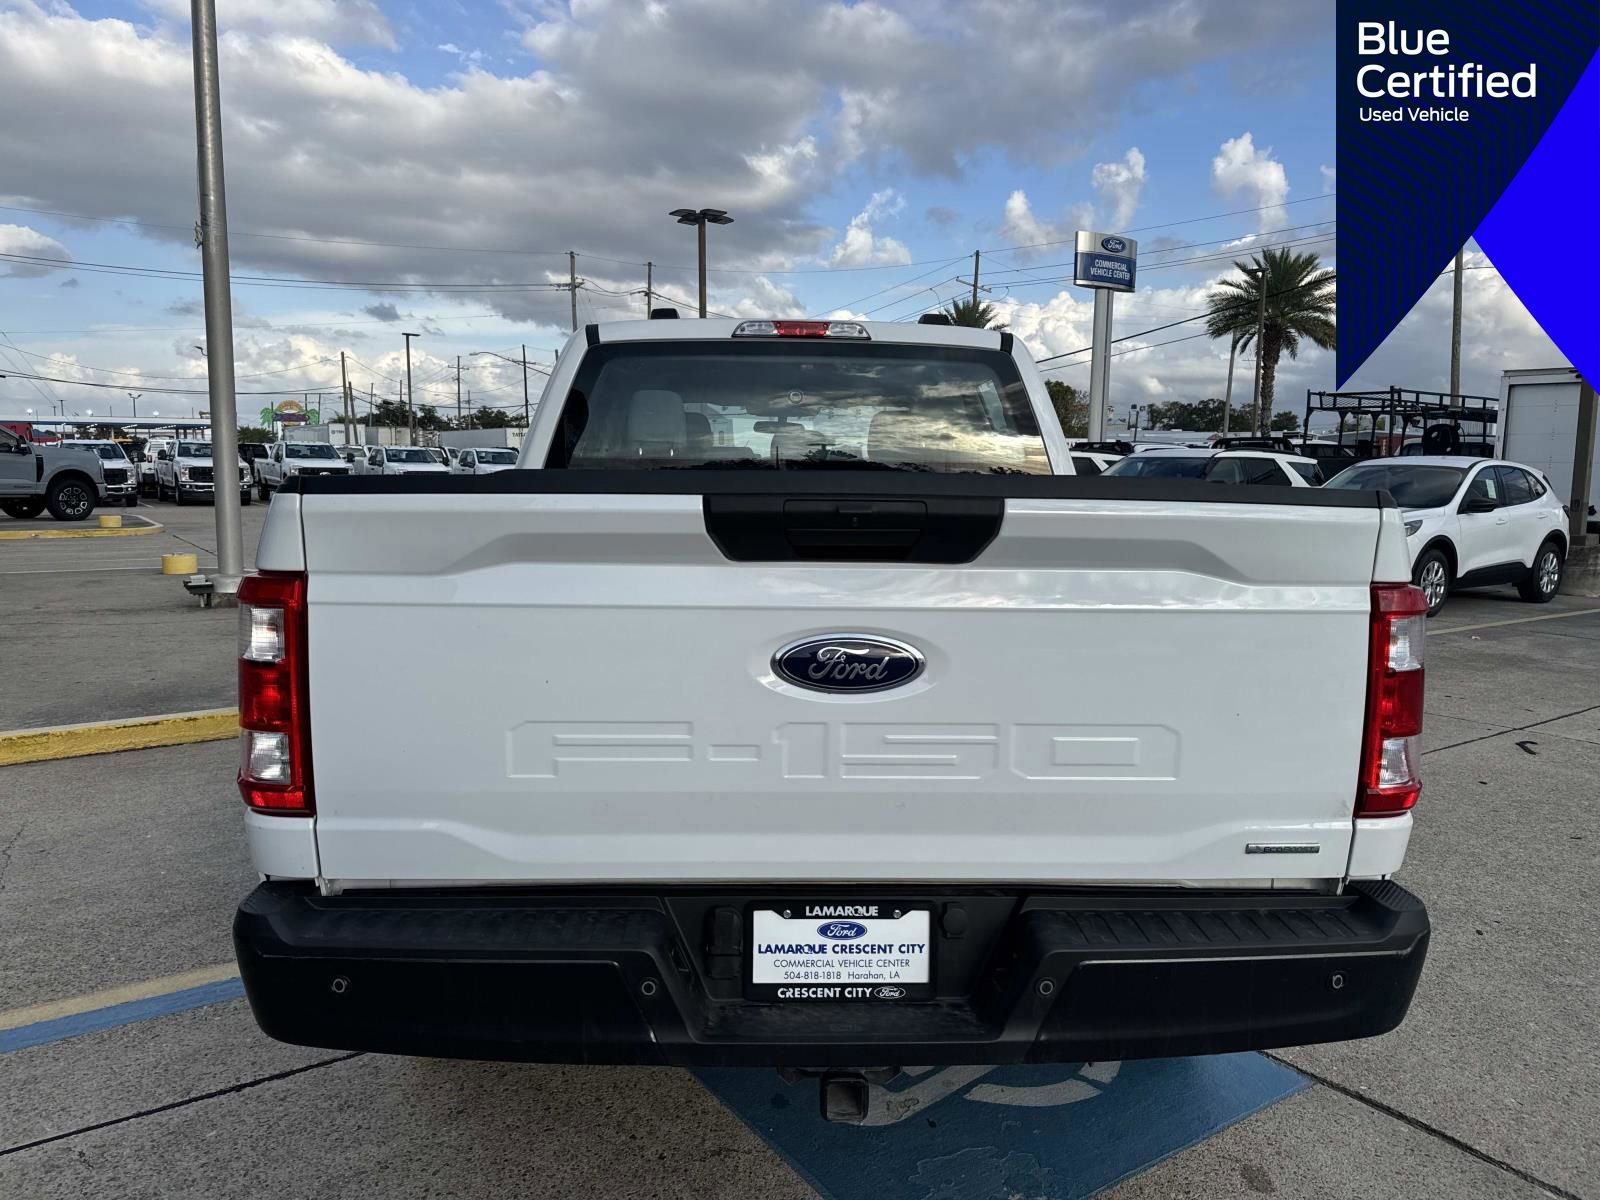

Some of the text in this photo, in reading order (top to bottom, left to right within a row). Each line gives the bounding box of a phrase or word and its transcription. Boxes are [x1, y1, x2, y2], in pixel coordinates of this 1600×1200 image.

[1095, 260, 1127, 271] COMMERCIAL
[1090, 267, 1130, 279] VEHICLE CENTER
[808, 647, 890, 680] Ford
[506, 721, 1180, 781] F-150
[805, 905, 879, 917] LAMARQUE
[827, 923, 857, 937] Ford
[758, 943, 926, 955] LAMARQUE CRESCENT CITY
[773, 959, 910, 968] COMMERCIAL VEHICLE CENTER
[783, 971, 900, 981] 504-818-1818 Harahan, LA
[777, 987, 873, 999] CRESCENT CITY
[879, 987, 900, 997] Ford
